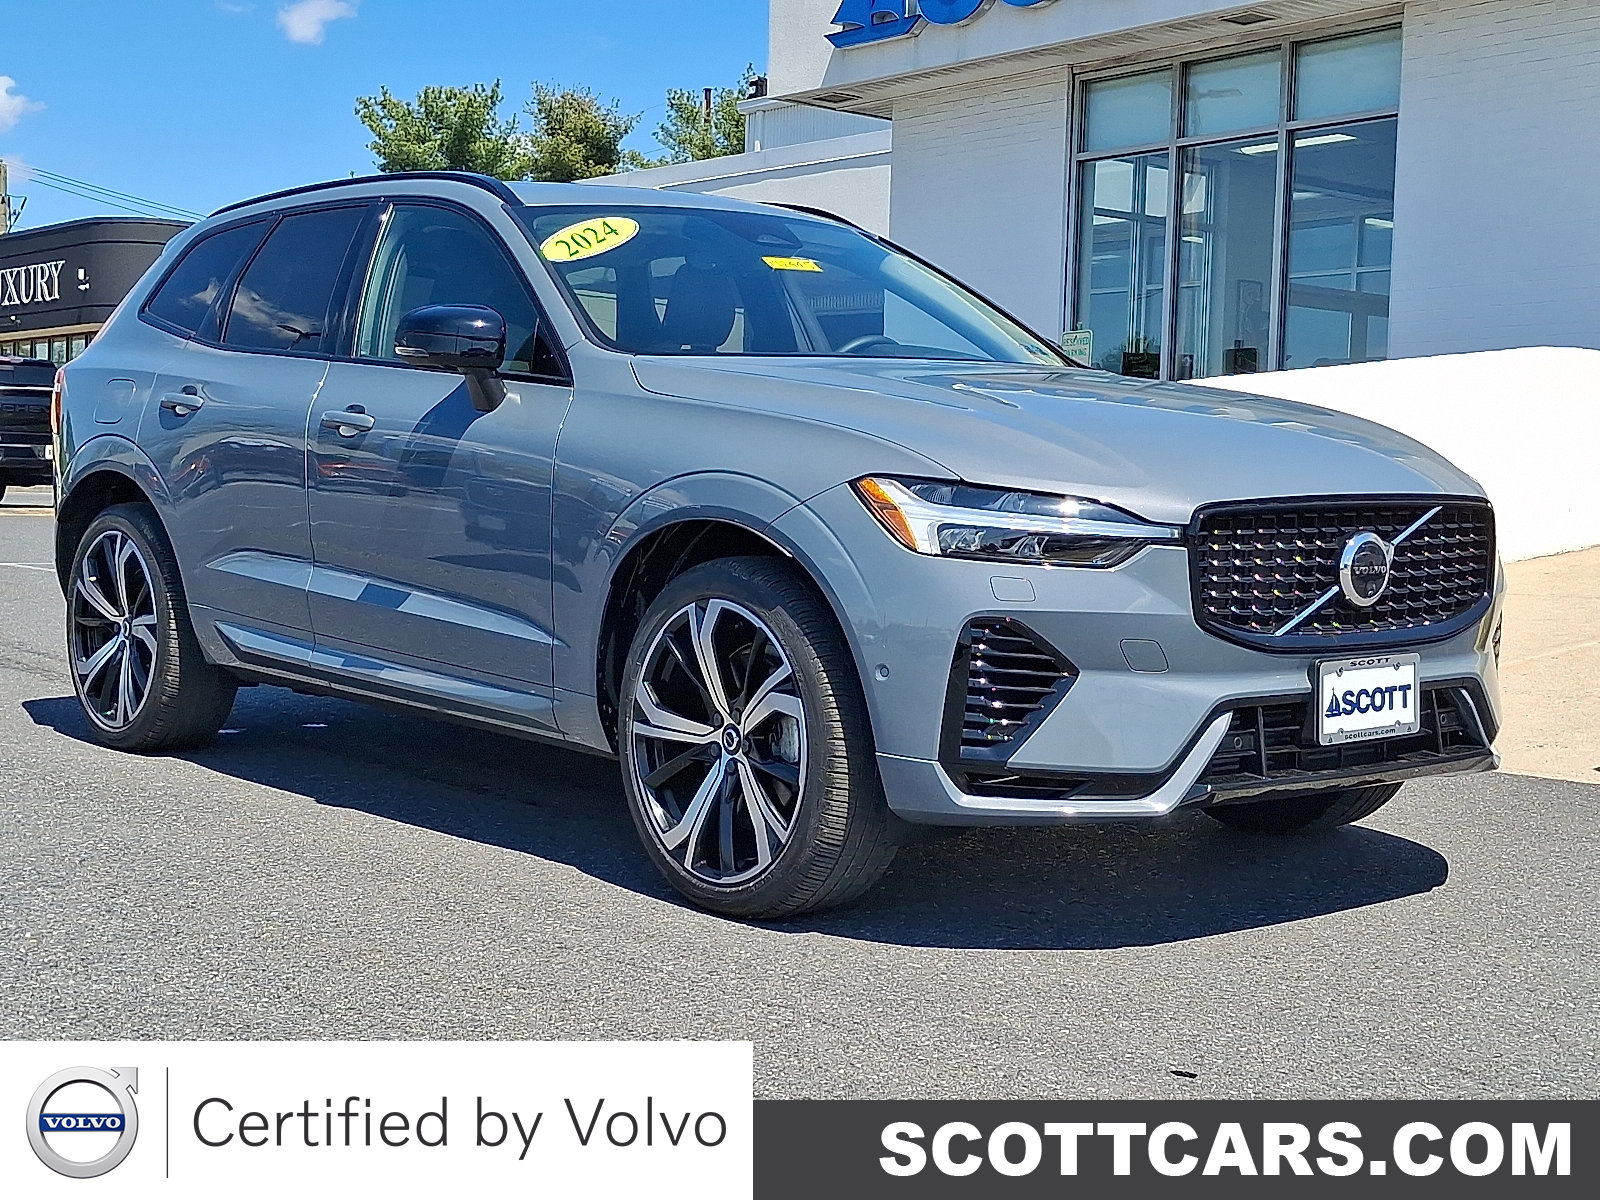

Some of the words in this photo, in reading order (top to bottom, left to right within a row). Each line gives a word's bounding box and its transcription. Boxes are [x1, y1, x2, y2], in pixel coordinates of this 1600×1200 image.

[555, 220, 619, 257] 2024
[0, 260, 66, 305] XURY
[1352, 565, 1387, 575] VOLVO
[1350, 657, 1391, 667] SCOTT
[1341, 684, 1412, 716] SCOTT
[1344, 727, 1396, 740] scottcars.com
